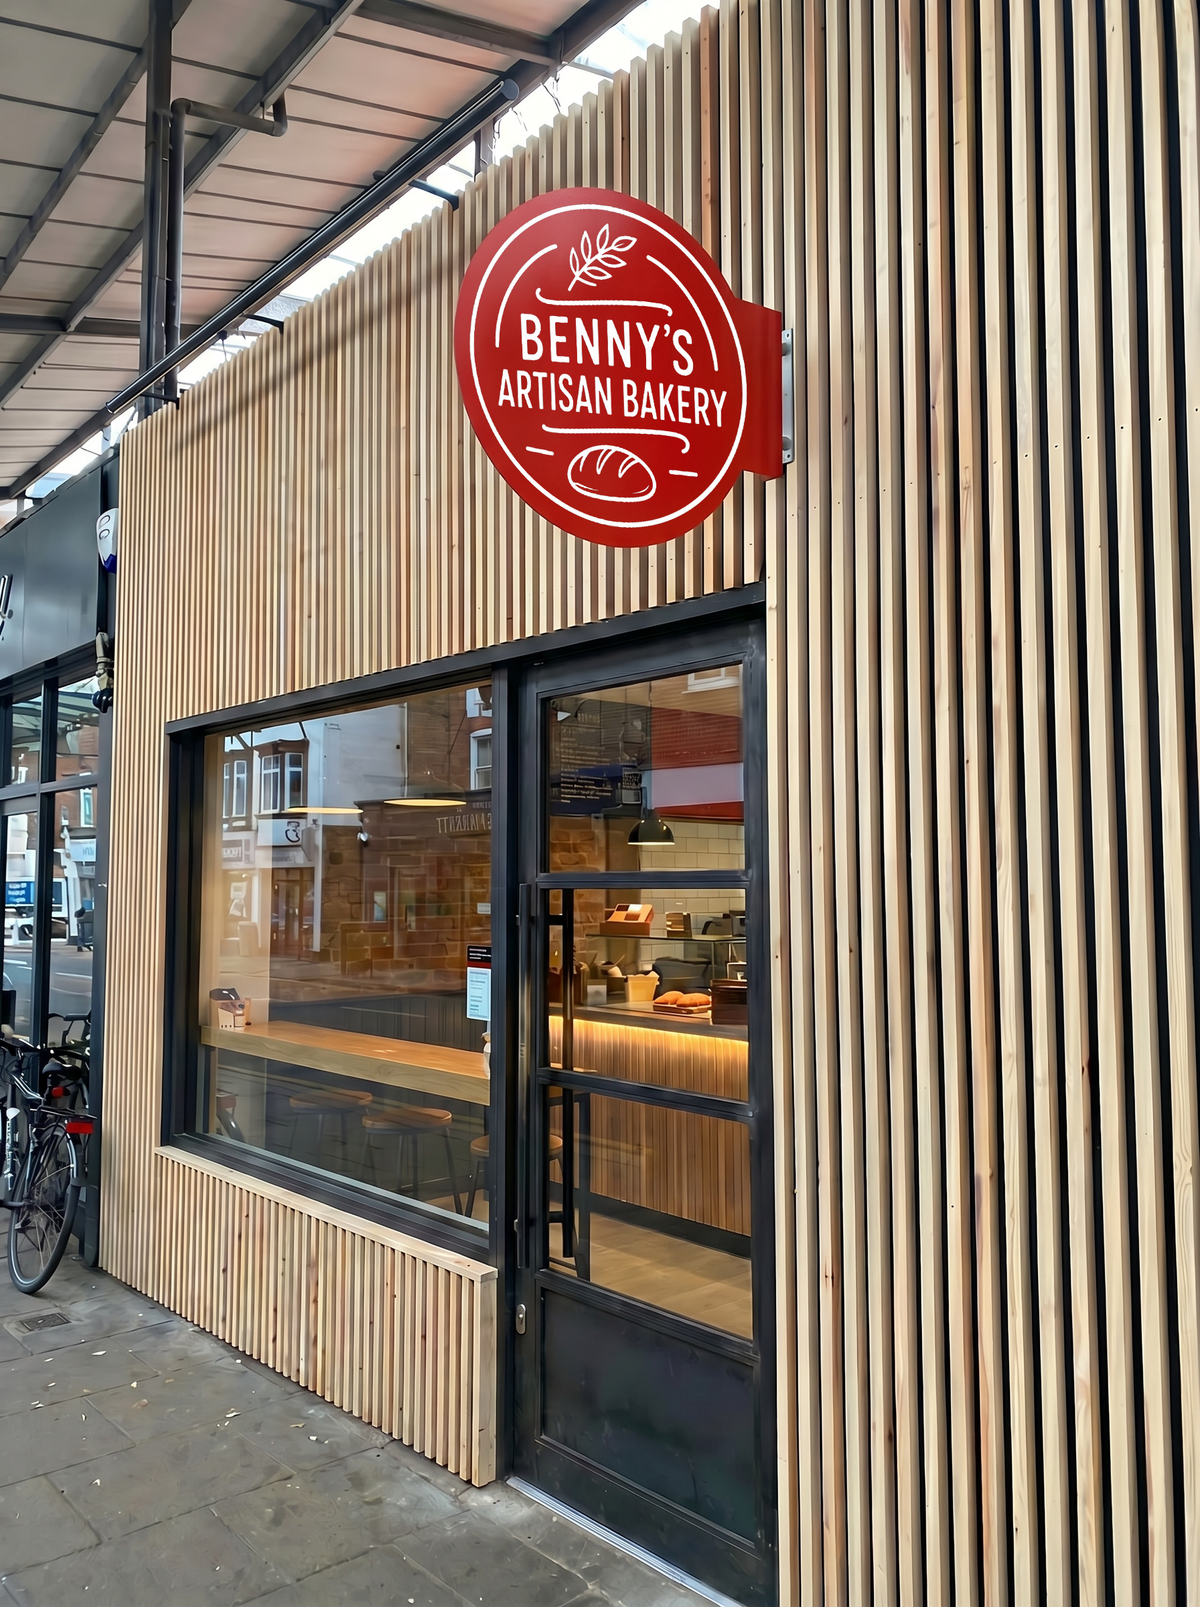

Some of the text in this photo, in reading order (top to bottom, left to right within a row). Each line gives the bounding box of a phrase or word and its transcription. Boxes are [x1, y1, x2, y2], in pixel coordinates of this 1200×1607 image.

[520, 313, 694, 377] BENNY'S
[498, 369, 728, 428] ARTISAN BAKERY
